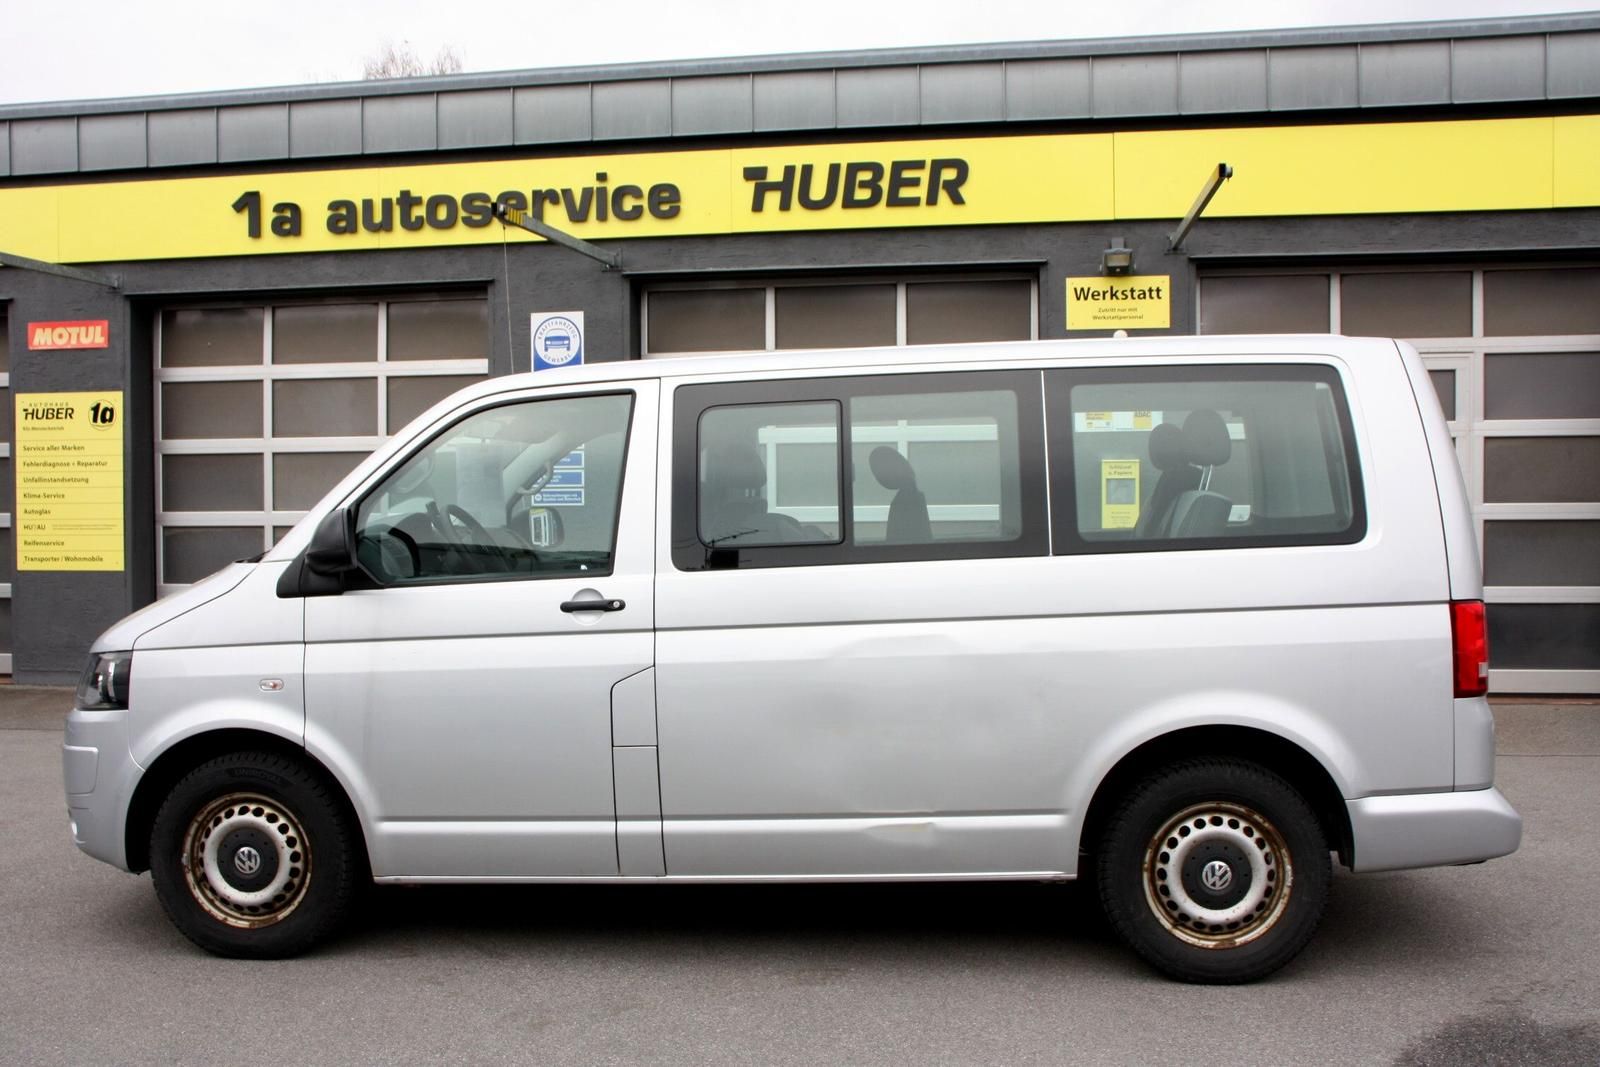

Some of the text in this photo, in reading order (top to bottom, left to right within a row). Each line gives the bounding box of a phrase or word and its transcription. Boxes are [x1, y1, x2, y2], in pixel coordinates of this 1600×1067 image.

[743, 157, 969, 213] HUBER
[231, 172, 681, 239] 1a autoservice
[1074, 286, 1162, 300] Werkstatt
[33, 326, 105, 346] MOTUL
[22, 407, 75, 420] HUBER
[90, 402, 115, 424] 1a
